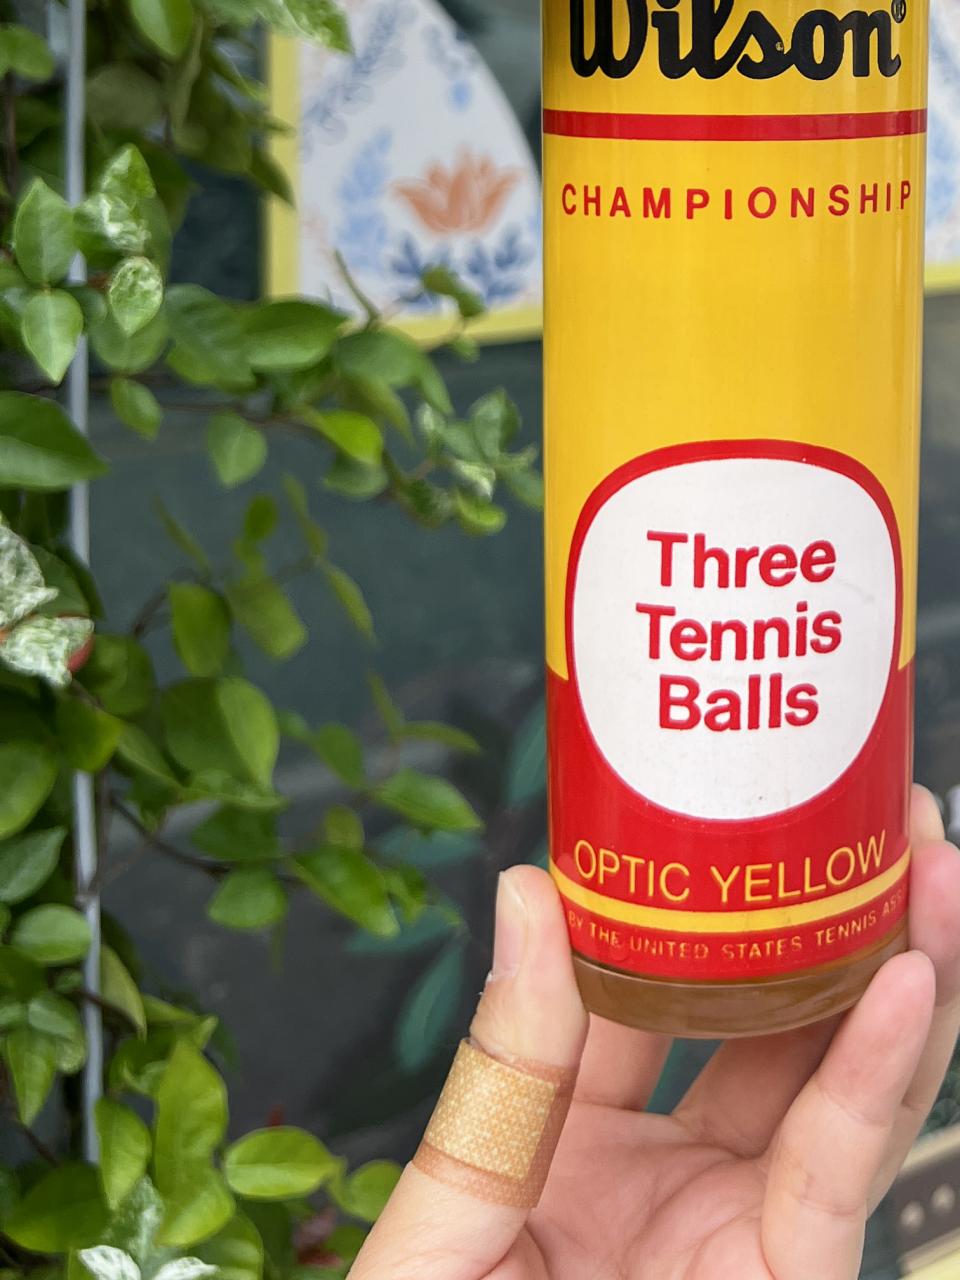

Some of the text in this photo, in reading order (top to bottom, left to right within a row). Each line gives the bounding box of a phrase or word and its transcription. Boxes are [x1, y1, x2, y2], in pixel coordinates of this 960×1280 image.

[562, 180, 911, 220] CHAMPIONSHIP
[646, 530, 837, 589] Three
[635, 600, 843, 662] Tennis
[659, 672, 820, 732] Balls
[574, 829, 887, 903] OPTIC YELLOW
[589, 922, 622, 947] THE
[630, 936, 709, 959] UNITED
[721, 936, 802, 959] STATES
[815, 910, 877, 946] TENNIS
